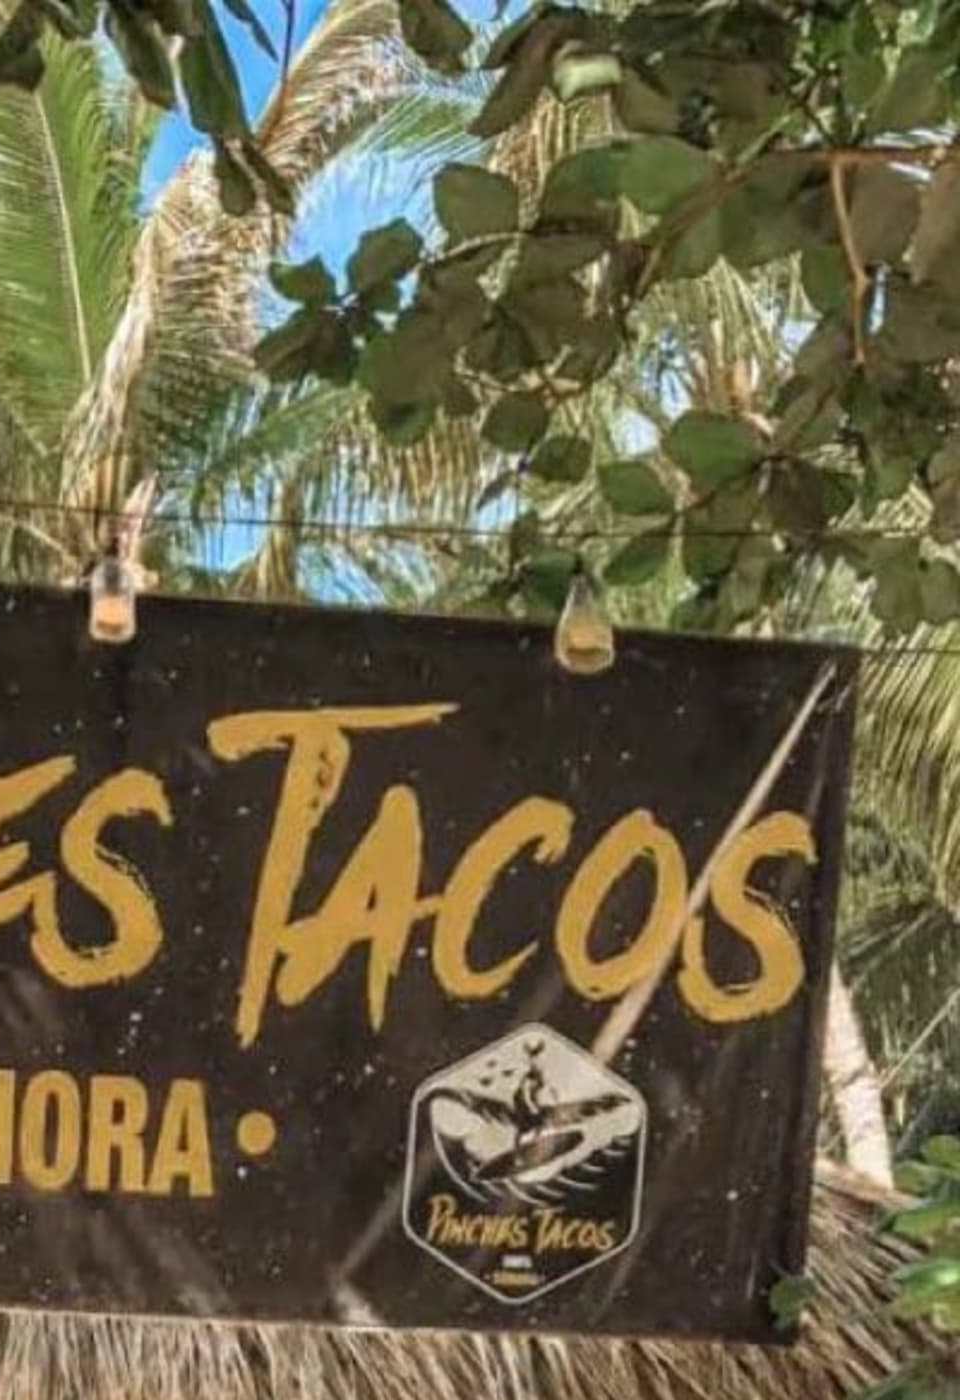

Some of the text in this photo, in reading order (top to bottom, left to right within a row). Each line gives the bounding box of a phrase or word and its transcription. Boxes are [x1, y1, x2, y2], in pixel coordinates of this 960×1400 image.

[206, 702, 817, 1049] TACOS
[426, 1193, 615, 1255] PINCHES TACOS
